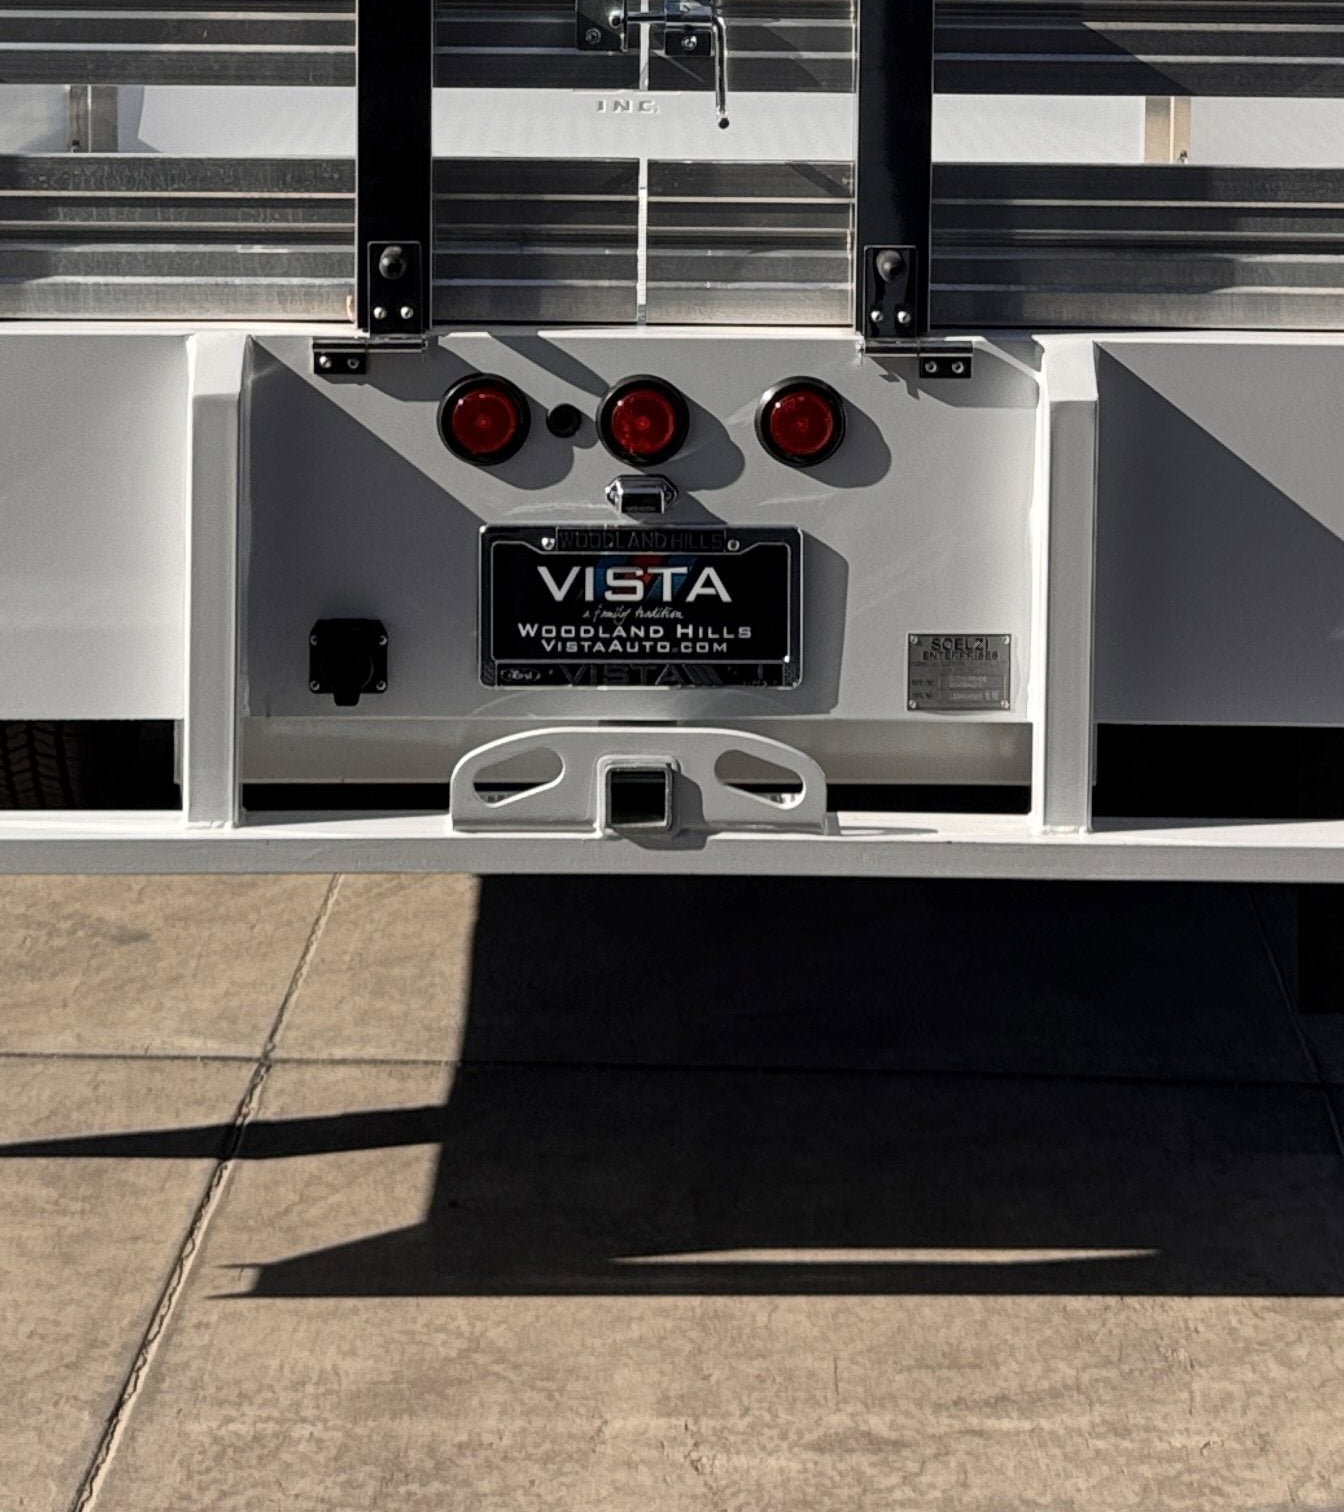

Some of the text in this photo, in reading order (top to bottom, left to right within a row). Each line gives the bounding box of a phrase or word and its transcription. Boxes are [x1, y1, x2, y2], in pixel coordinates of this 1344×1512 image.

[560, 531, 724, 550] WOODLAND HILLS
[537, 566, 732, 603] VISTA
